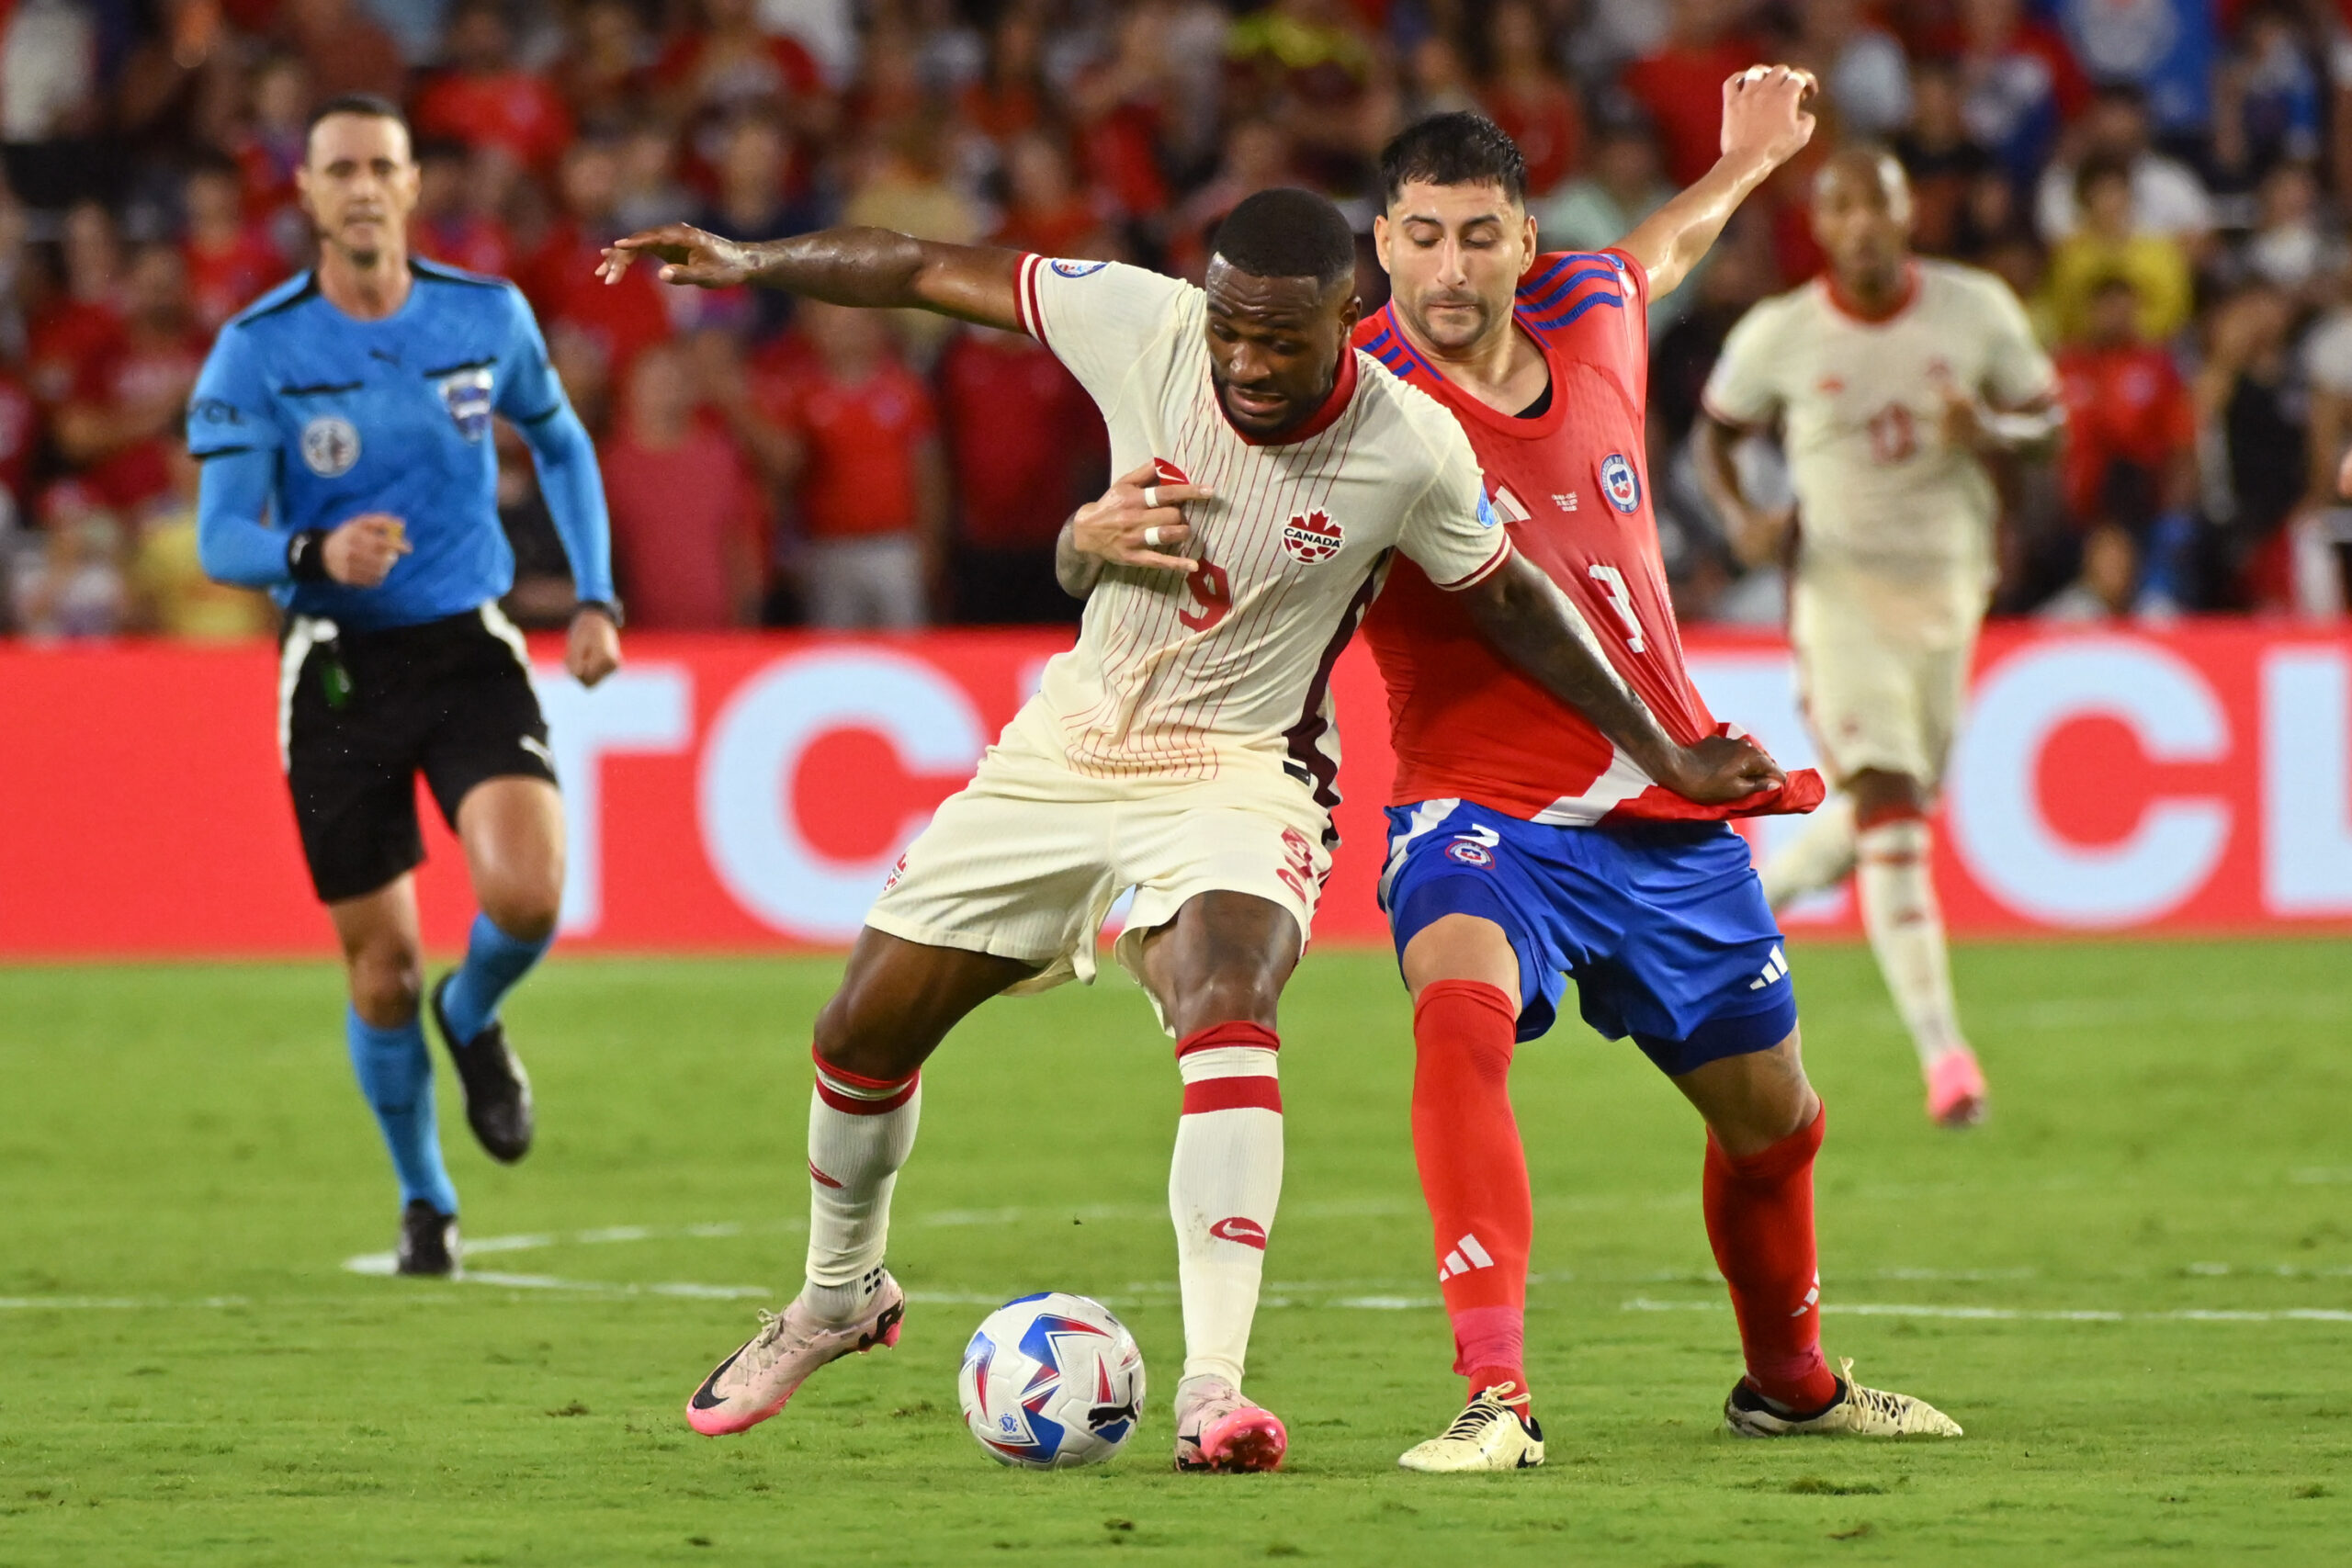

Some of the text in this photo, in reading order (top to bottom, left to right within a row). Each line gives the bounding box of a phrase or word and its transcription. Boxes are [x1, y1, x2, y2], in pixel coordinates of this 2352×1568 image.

[1283, 527, 1340, 548] CANADA
[1179, 555, 1231, 633] 9
[526, 646, 1136, 942] TC
